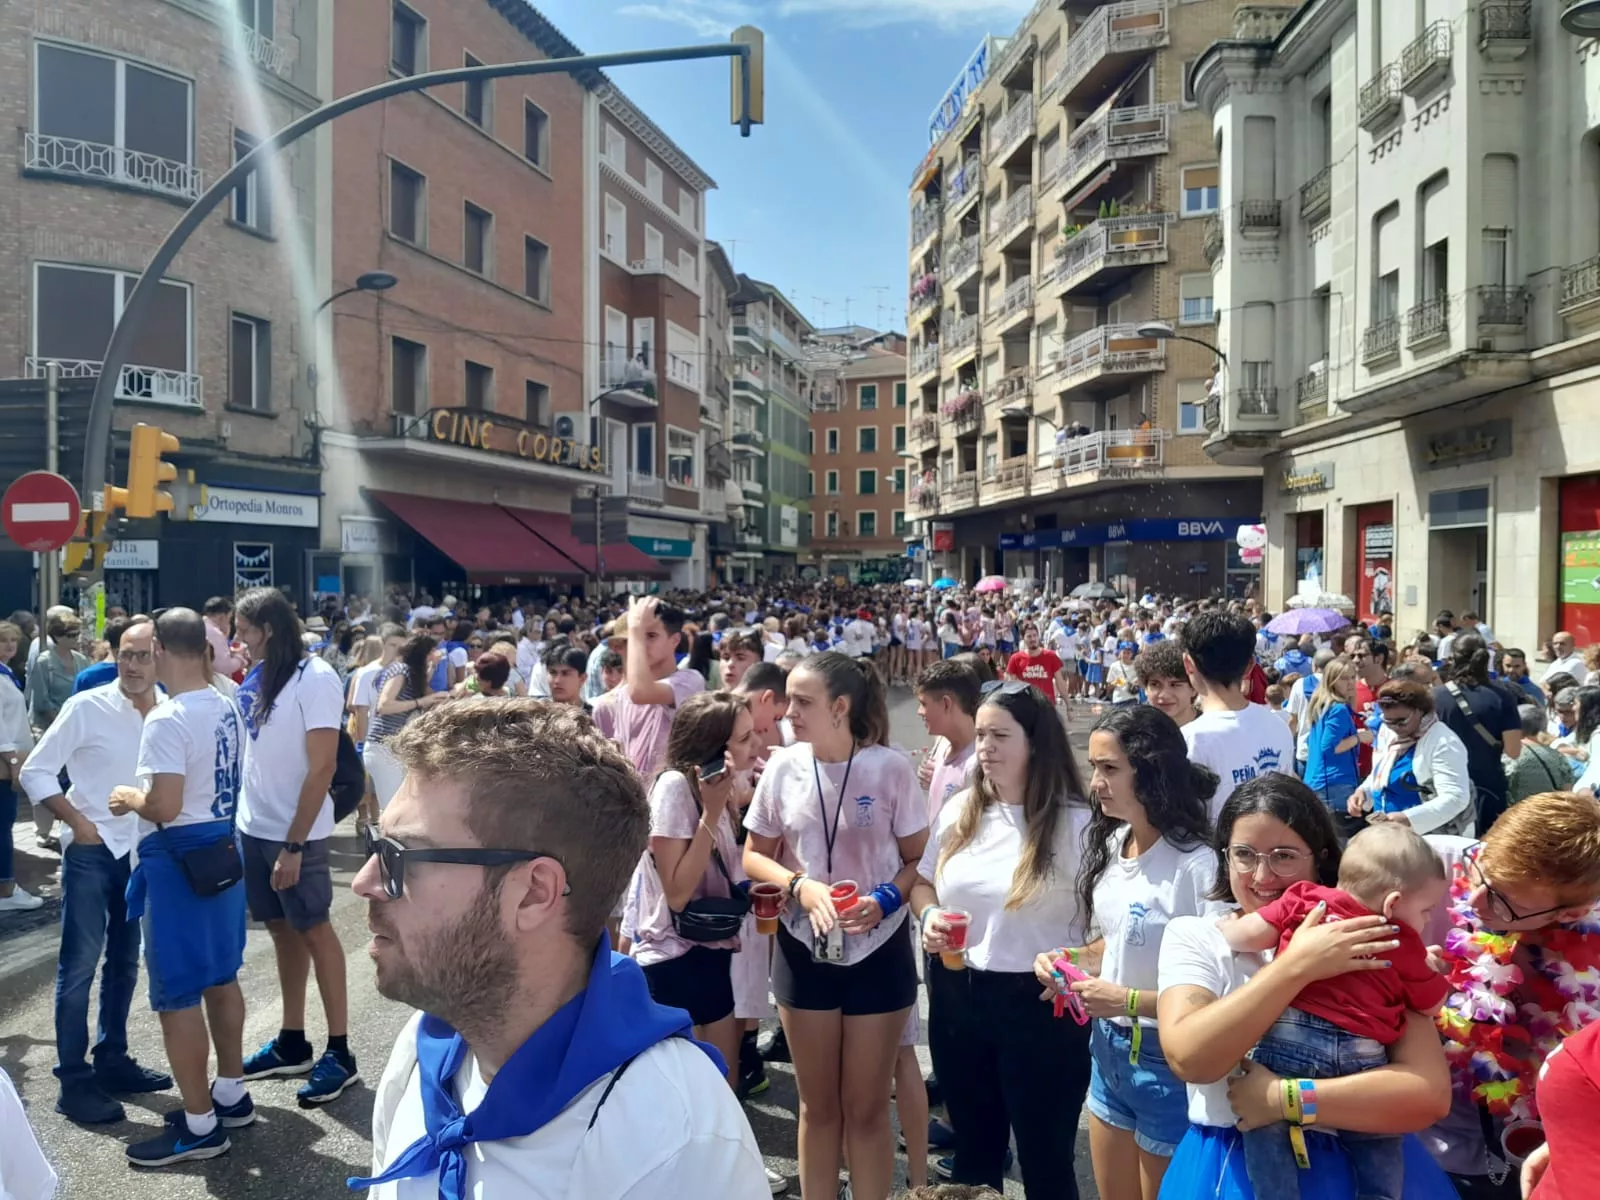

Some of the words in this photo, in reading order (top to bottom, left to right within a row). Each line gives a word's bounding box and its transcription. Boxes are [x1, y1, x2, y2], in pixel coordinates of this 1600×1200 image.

[433, 409, 494, 450] CINE
[209, 495, 262, 515] Ortopedia
[265, 500, 303, 516] Monros
[1177, 520, 1225, 536] BBVA
[1231, 764, 1257, 784] PEÑA
